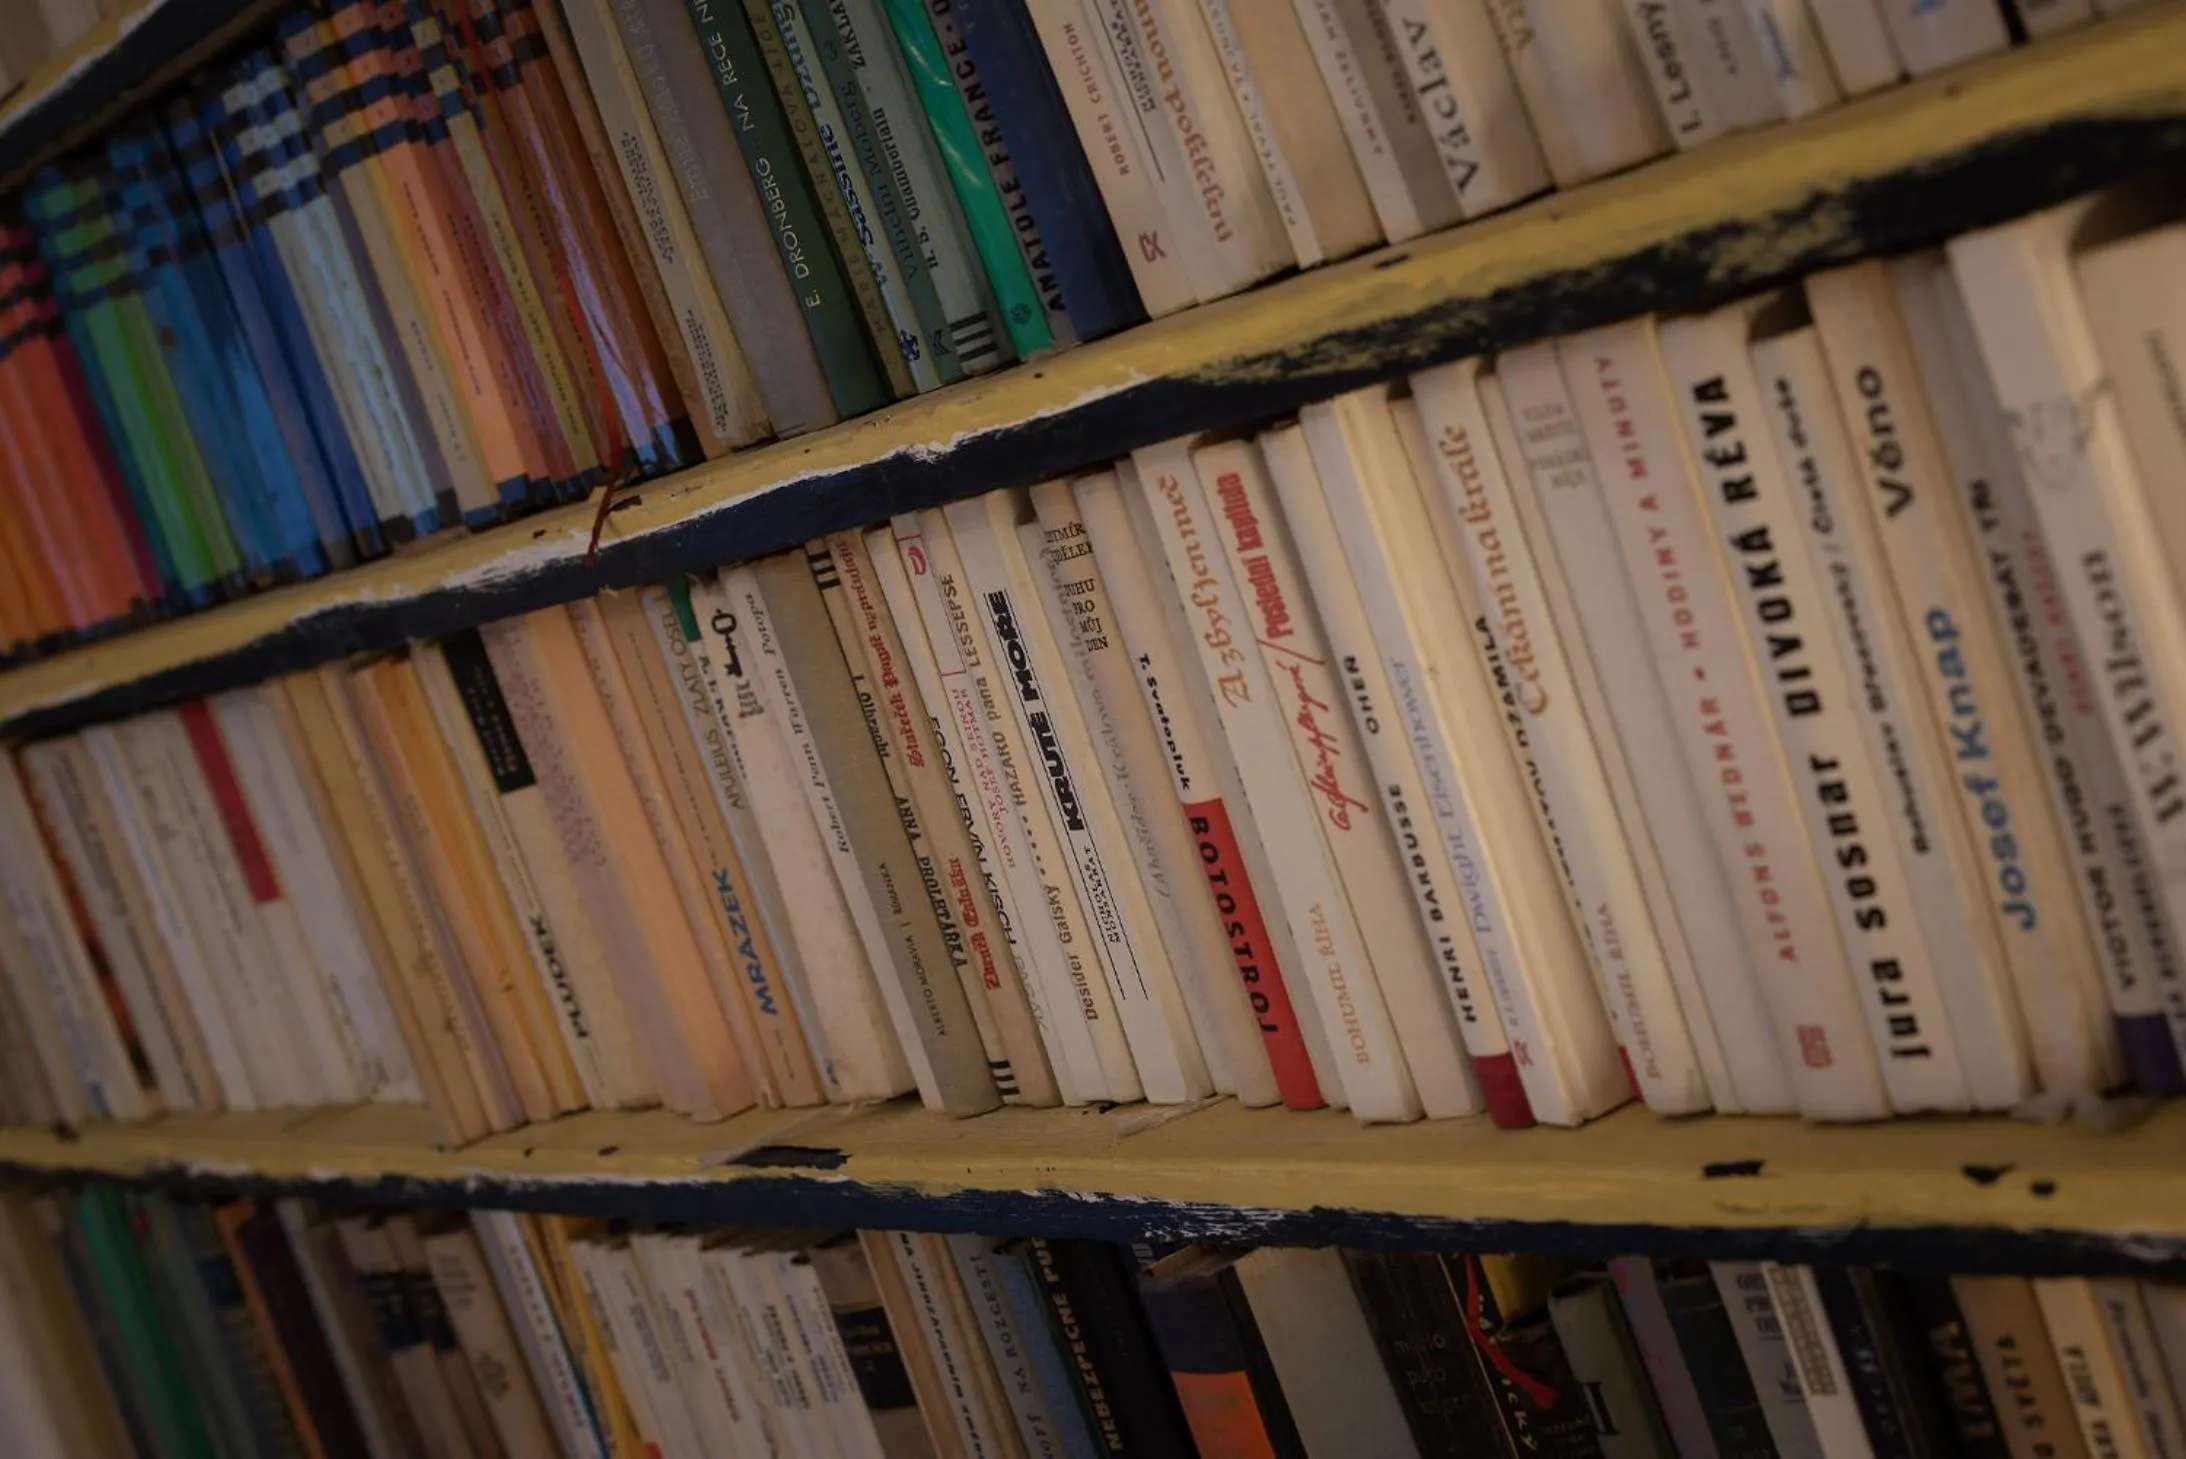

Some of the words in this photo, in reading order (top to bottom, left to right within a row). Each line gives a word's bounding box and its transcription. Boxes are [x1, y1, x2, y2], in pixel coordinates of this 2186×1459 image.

[948, 38, 1010, 165] FRANCE
[1064, 23, 1100, 103] CRICHTON
[734, 94, 754, 130] NA
[840, 81, 881, 175] Moberg
[1098, 114, 1129, 175] ROBERT
[1405, 21, 1478, 197] Václav
[756, 158, 809, 278] DRONBERG
[878, 184, 917, 279] Vilhelm
[1002, 176, 1067, 311] ANATOLE
[806, 290, 820, 307] E.
[1694, 378, 1755, 502] RÉVA
[1857, 367, 1912, 516] Věno
[1218, 474, 1261, 551] kapitola
[1640, 493, 1657, 511] A
[745, 594, 775, 654] Potopa
[940, 575, 980, 667] LESSEPSE
[1244, 556, 1292, 638] Poslední
[1650, 529, 1698, 648] HODINY
[1733, 528, 1820, 715] DIVOKÁ
[987, 592, 1038, 701] MOŘE
[1927, 610, 1987, 759] Knap
[776, 669, 803, 734] Warren
[952, 689, 977, 750] SEINOU
[976, 677, 1001, 720] pana
[1140, 654, 1150, 670] T.
[1147, 677, 1189, 789] Svatopluk
[1393, 662, 1454, 818] Eisenhower
[707, 729, 744, 809] APULEIUS
[802, 744, 824, 787] Penn
[976, 759, 990, 791] NAD
[986, 768, 1008, 817] JOSEF
[992, 732, 1026, 806] HAZARD
[1030, 713, 1083, 832] KRUTÉ
[2056, 757, 2094, 853] HUGO
[822, 797, 849, 852] Robert
[893, 796, 921, 843] ANNA
[989, 798, 1015, 867] HOVORY
[1390, 786, 1442, 921] BARBUSSE
[1966, 778, 2035, 930] Josef
[1043, 885, 1072, 943] Galský
[1084, 847, 1120, 942] MONSARRAT
[1085, 861, 1115, 942] NICHOLAS
[1191, 817, 1277, 1032] BOTOSTROJ
[1448, 835, 1491, 932] Dwight
[1746, 845, 1795, 960] ALFONS
[906, 936, 927, 985] MORAVIA
[1309, 904, 1335, 956] ŘÍHA
[2089, 868, 2134, 988] VICTOR
[924, 989, 946, 1035] ALBERTO
[1069, 956, 1098, 1020] Desider
[1329, 964, 1370, 1064] BOHUMIL
[1440, 938, 1476, 1022] HENRI
[1618, 974, 1661, 1079] BOHUMIL
[1015, 1368, 1031, 1393] NA
